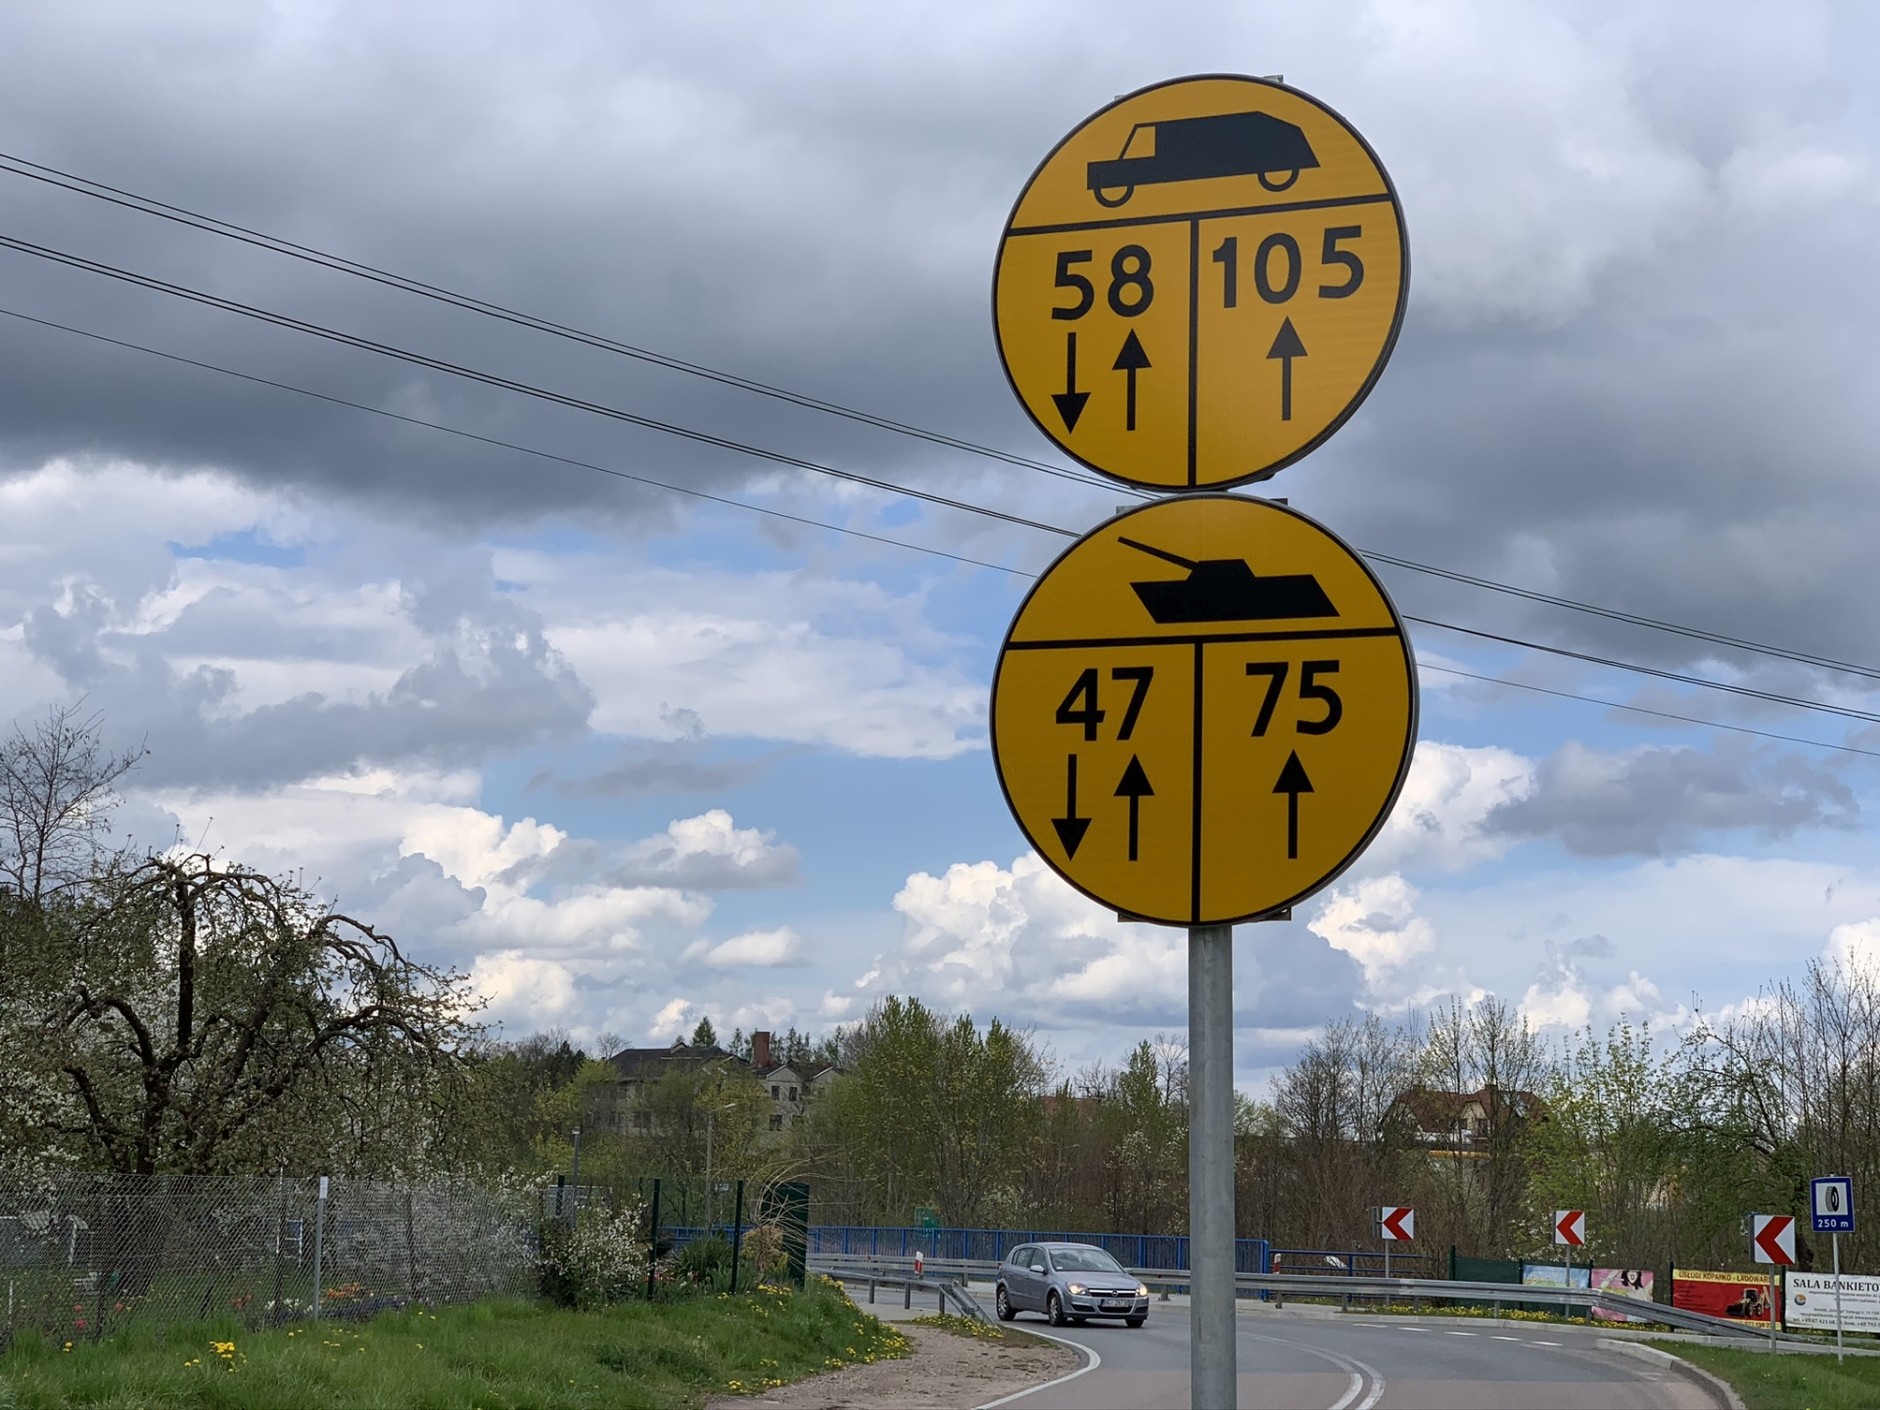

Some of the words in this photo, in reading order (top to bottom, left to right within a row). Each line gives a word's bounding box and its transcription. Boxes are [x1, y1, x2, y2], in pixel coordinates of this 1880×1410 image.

[1051, 245, 1154, 320] 58
[1213, 225, 1364, 308] 105
[1055, 666, 1154, 742] 47
[1245, 659, 1343, 737] 75
[1818, 1219, 1837, 1228] 250
[1678, 1271, 1702, 1279] USŁUGI
[1793, 1279, 1820, 1289] SALA
[1823, 1280, 1880, 1292] BANKIETO
